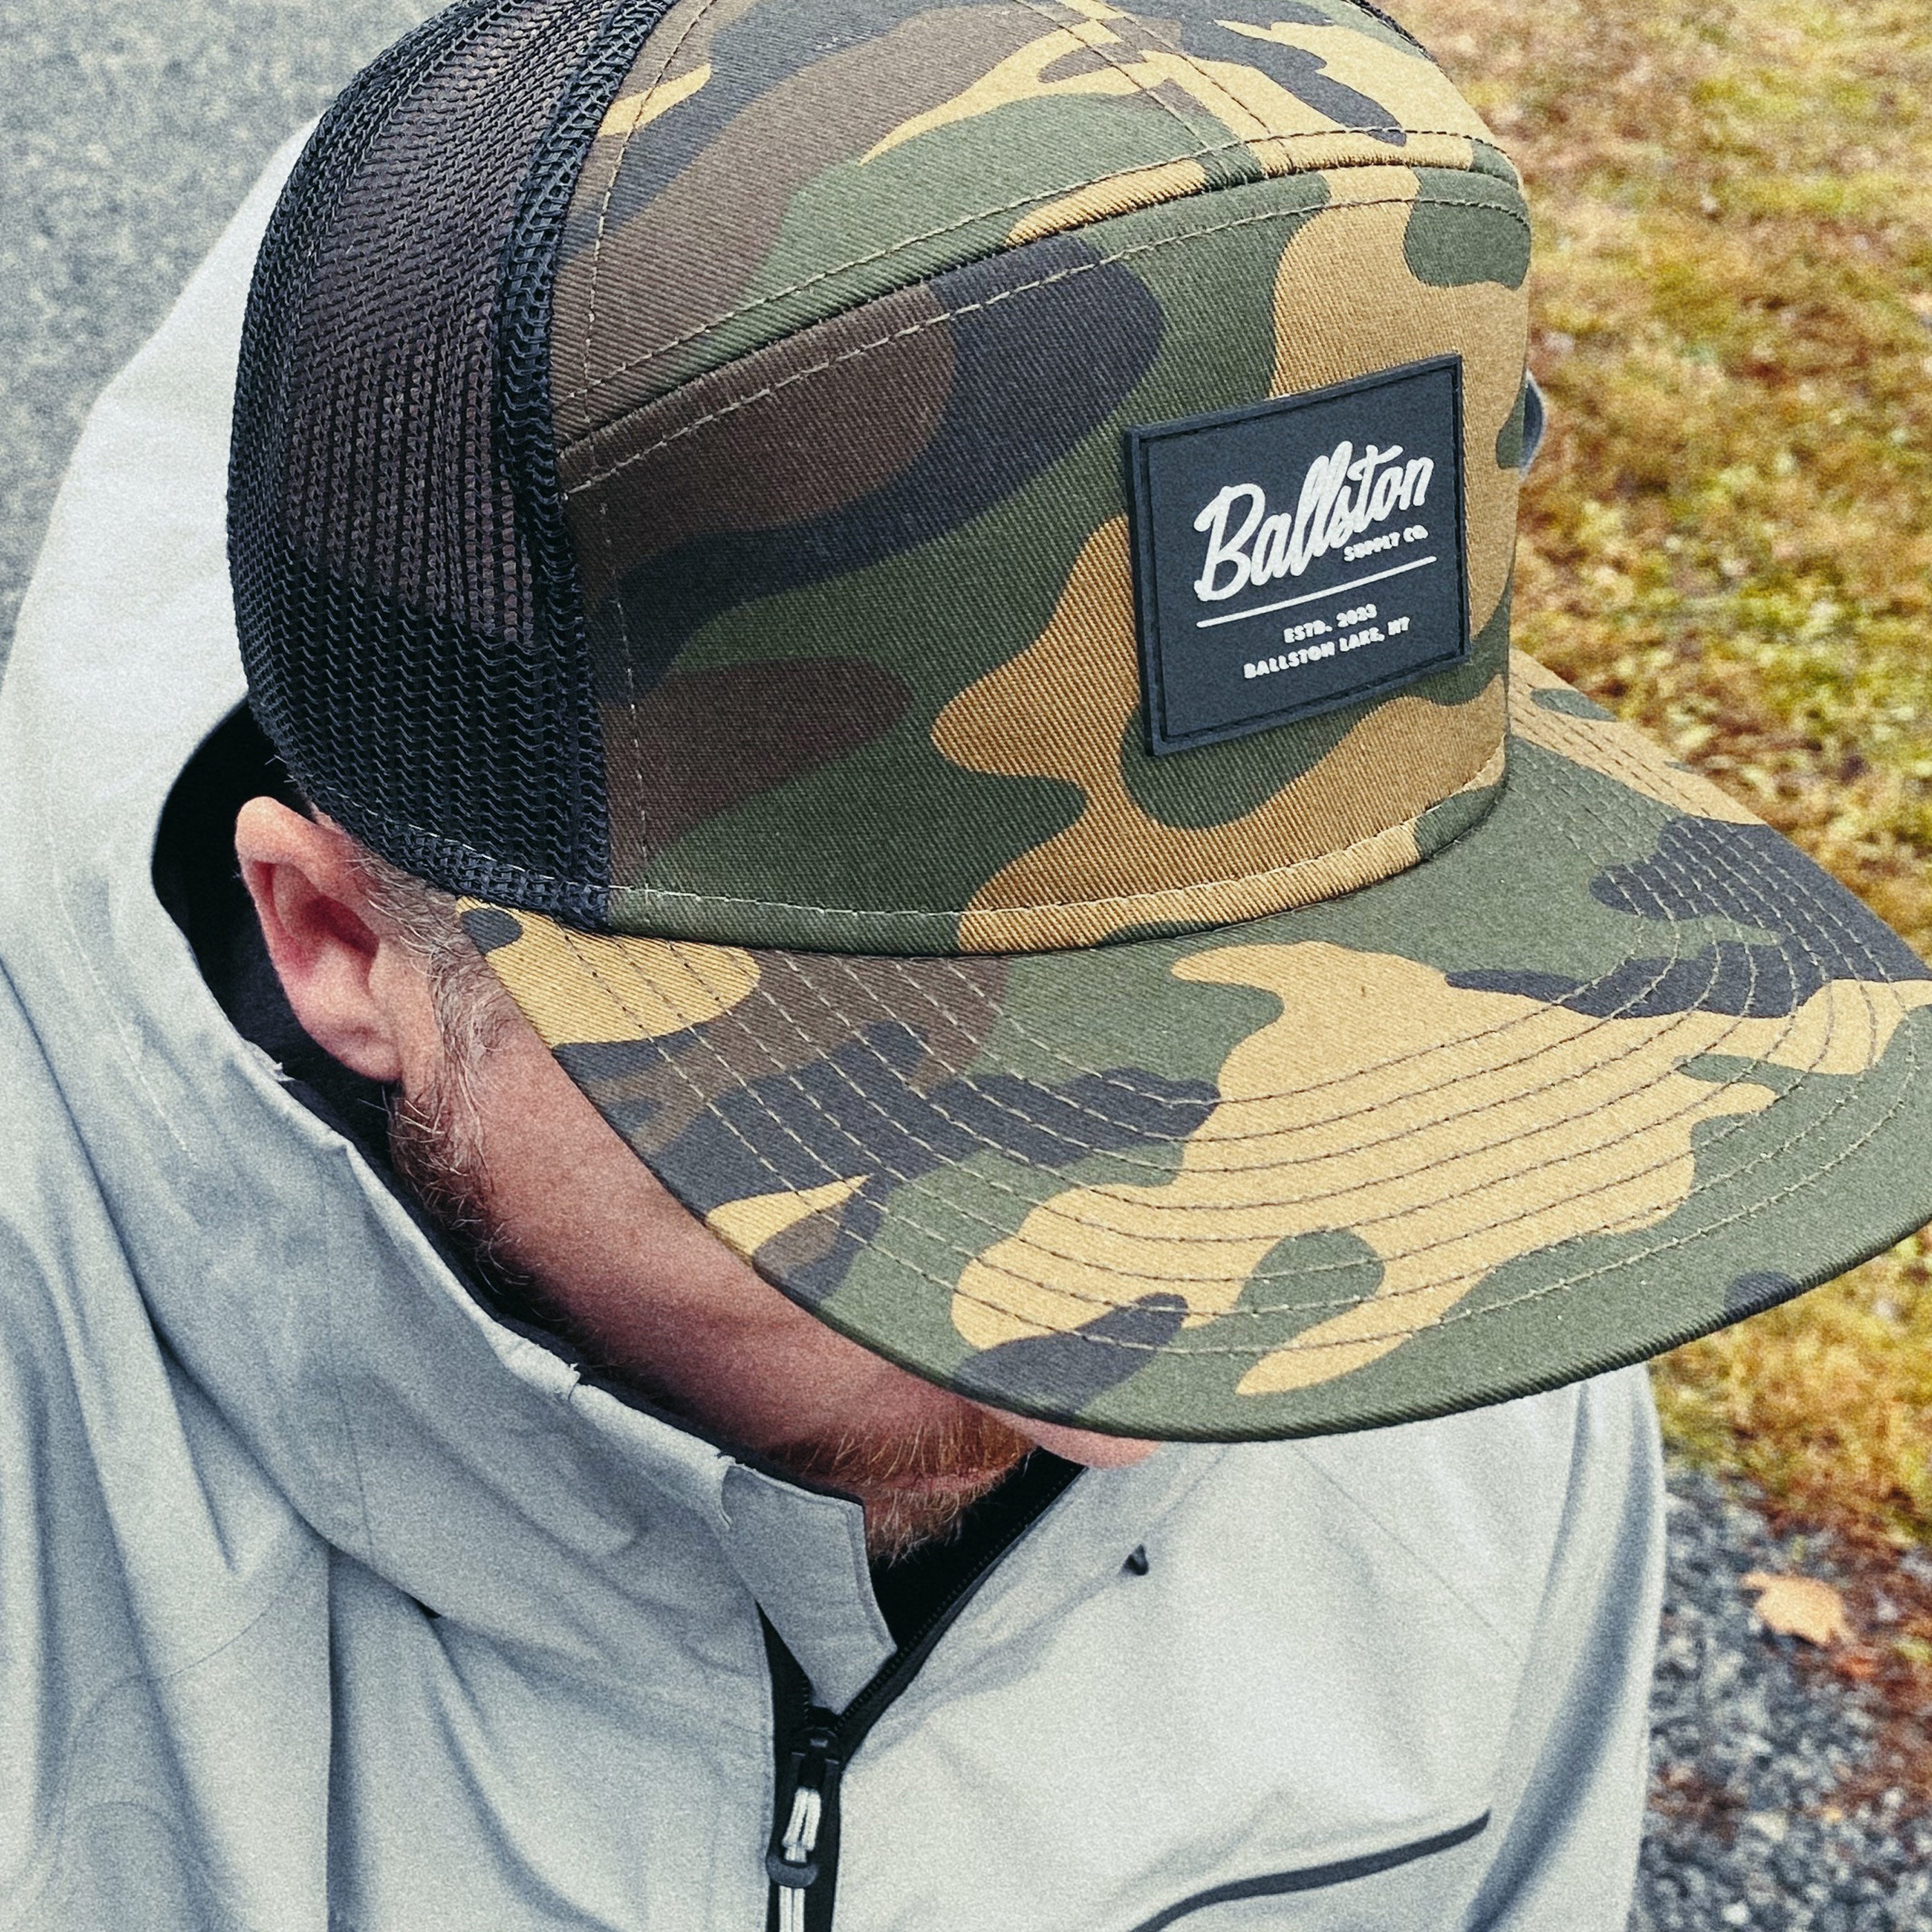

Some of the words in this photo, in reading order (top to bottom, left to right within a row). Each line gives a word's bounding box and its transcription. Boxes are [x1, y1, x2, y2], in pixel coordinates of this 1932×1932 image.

[1193, 440, 1435, 602] Ballston
[1343, 531, 1401, 562] SUPPLY
[1336, 603, 1378, 628] 2023
[1243, 641, 1335, 679] BALLSTON
[1339, 627, 1386, 652] LAKE,
[1387, 616, 1410, 635] NY
